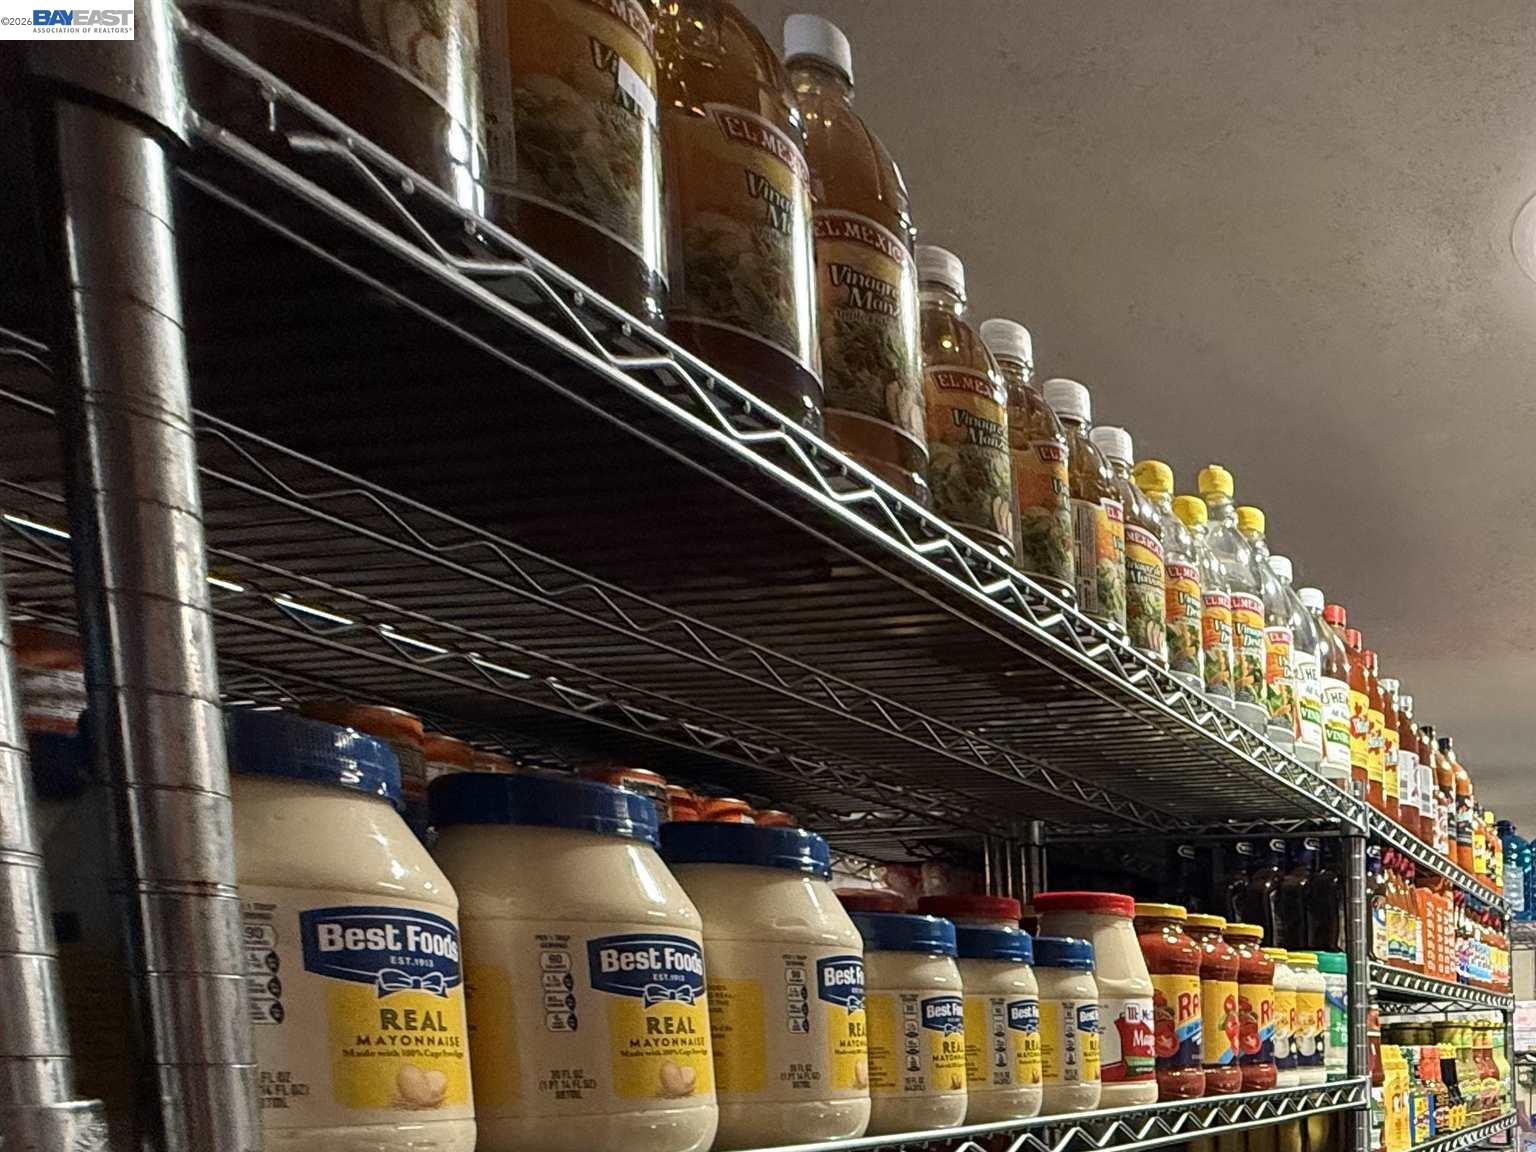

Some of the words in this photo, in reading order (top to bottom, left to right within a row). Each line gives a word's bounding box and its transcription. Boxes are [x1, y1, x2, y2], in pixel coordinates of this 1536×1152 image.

[316, 922, 402, 952] Best
[406, 924, 459, 963] Foods
[600, 947, 661, 973] Best
[664, 947, 704, 976] Foods
[823, 966, 856, 987] Best
[379, 1008, 448, 1033] REAL
[925, 1004, 951, 1019] Best
[1010, 1007, 1032, 1020] Best
[646, 1015, 696, 1035] REAL
[356, 1034, 461, 1048] MAYONNAISE
[629, 1037, 705, 1048] MAYONNAISE
